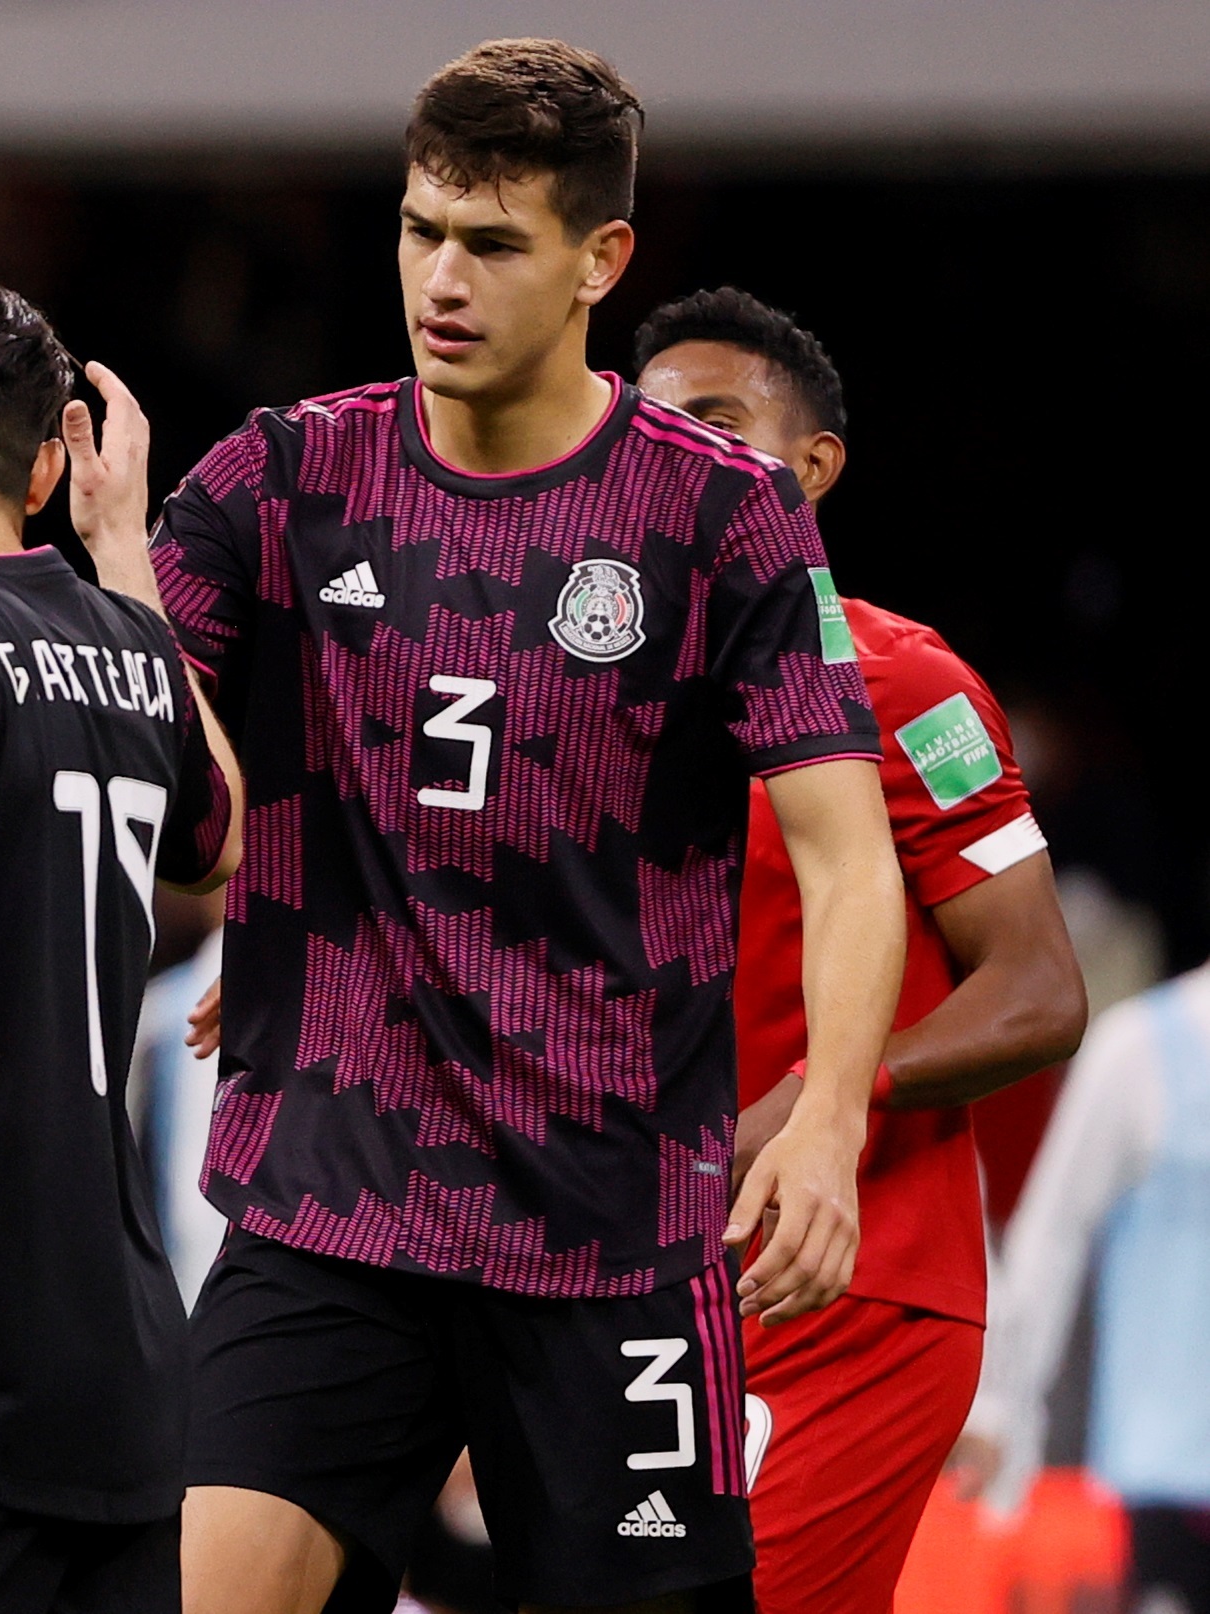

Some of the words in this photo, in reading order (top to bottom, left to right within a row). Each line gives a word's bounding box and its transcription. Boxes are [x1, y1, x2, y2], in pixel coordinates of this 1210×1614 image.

[319, 586, 386, 609] adidas
[417, 674, 497, 811] 3
[915, 717, 975, 760] LIVING
[919, 726, 981, 767] FOOTBALL
[962, 742, 990, 767] FIFA
[620, 1338, 696, 1470] 3
[617, 1520, 687, 1538] adidas
